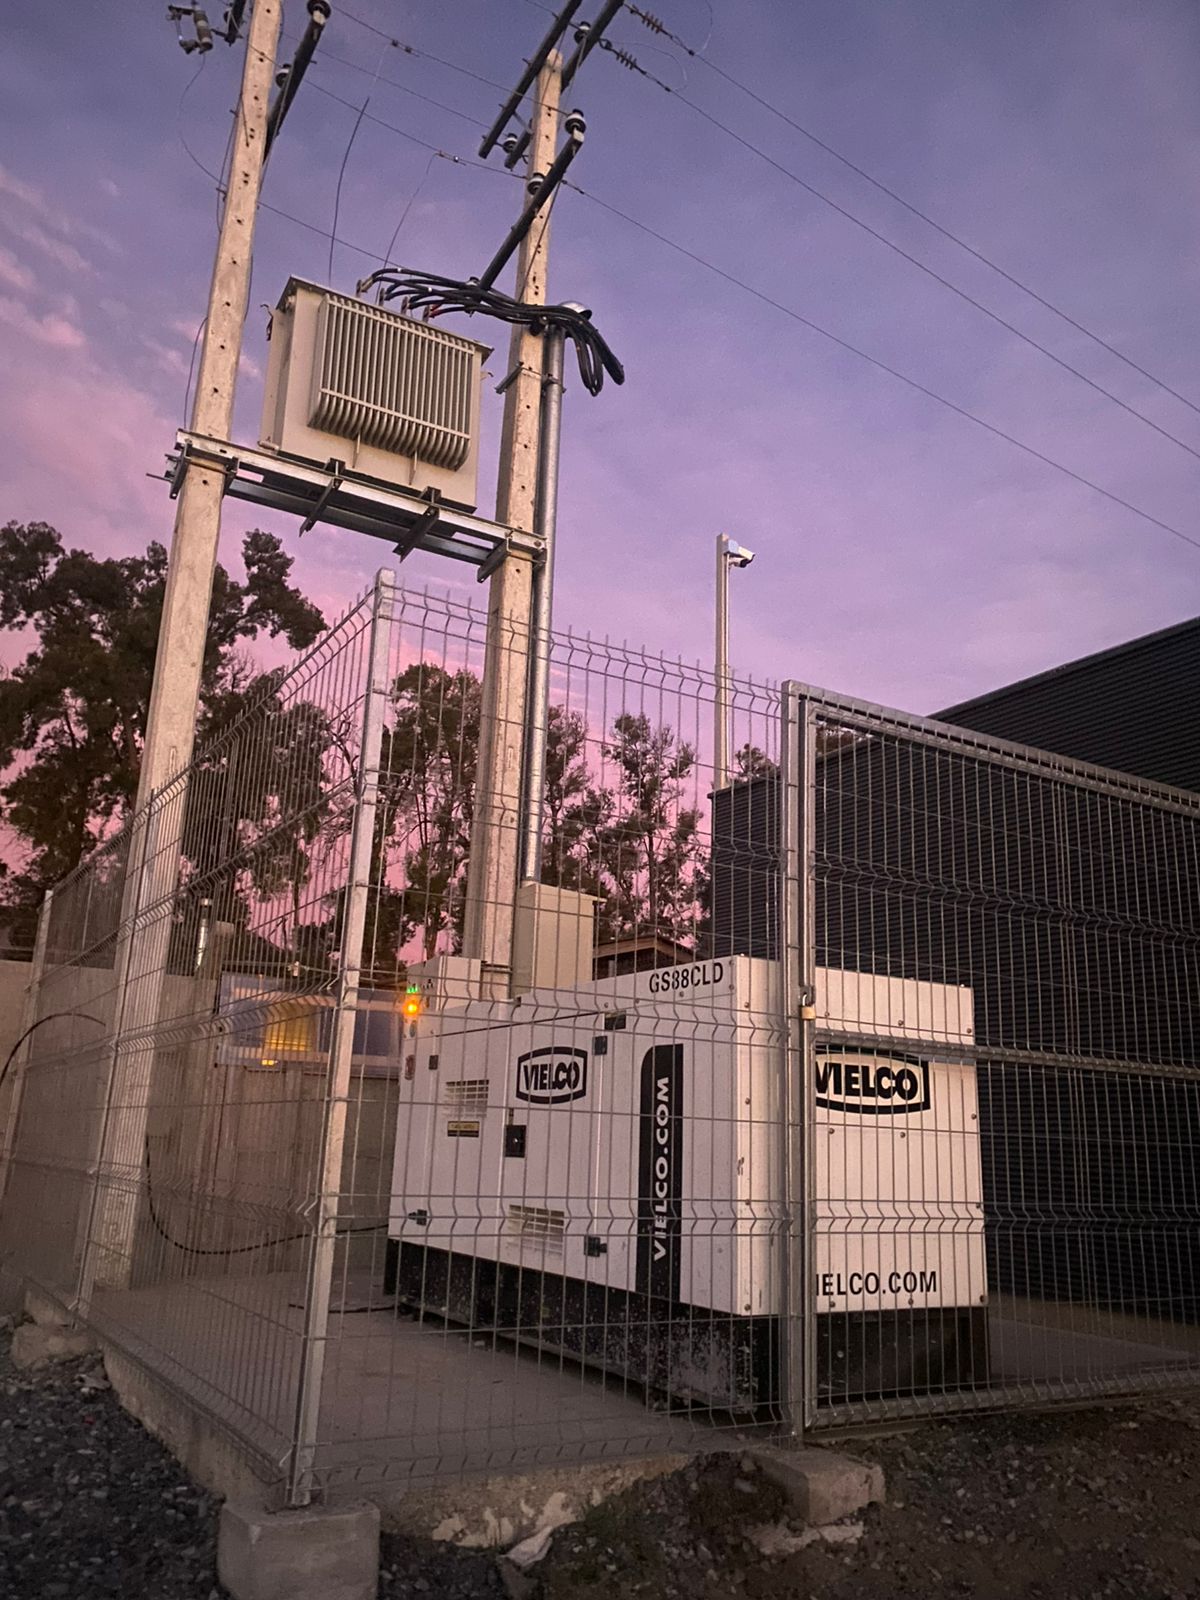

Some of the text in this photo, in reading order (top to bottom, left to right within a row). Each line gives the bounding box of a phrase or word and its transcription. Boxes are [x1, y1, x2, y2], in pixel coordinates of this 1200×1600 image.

[649, 962, 723, 993] GS88CLD
[523, 1061, 580, 1090] VIELCO
[654, 1077, 669, 1261] VIELCO.COM
[816, 1271, 936, 1296] IELCO.COM
